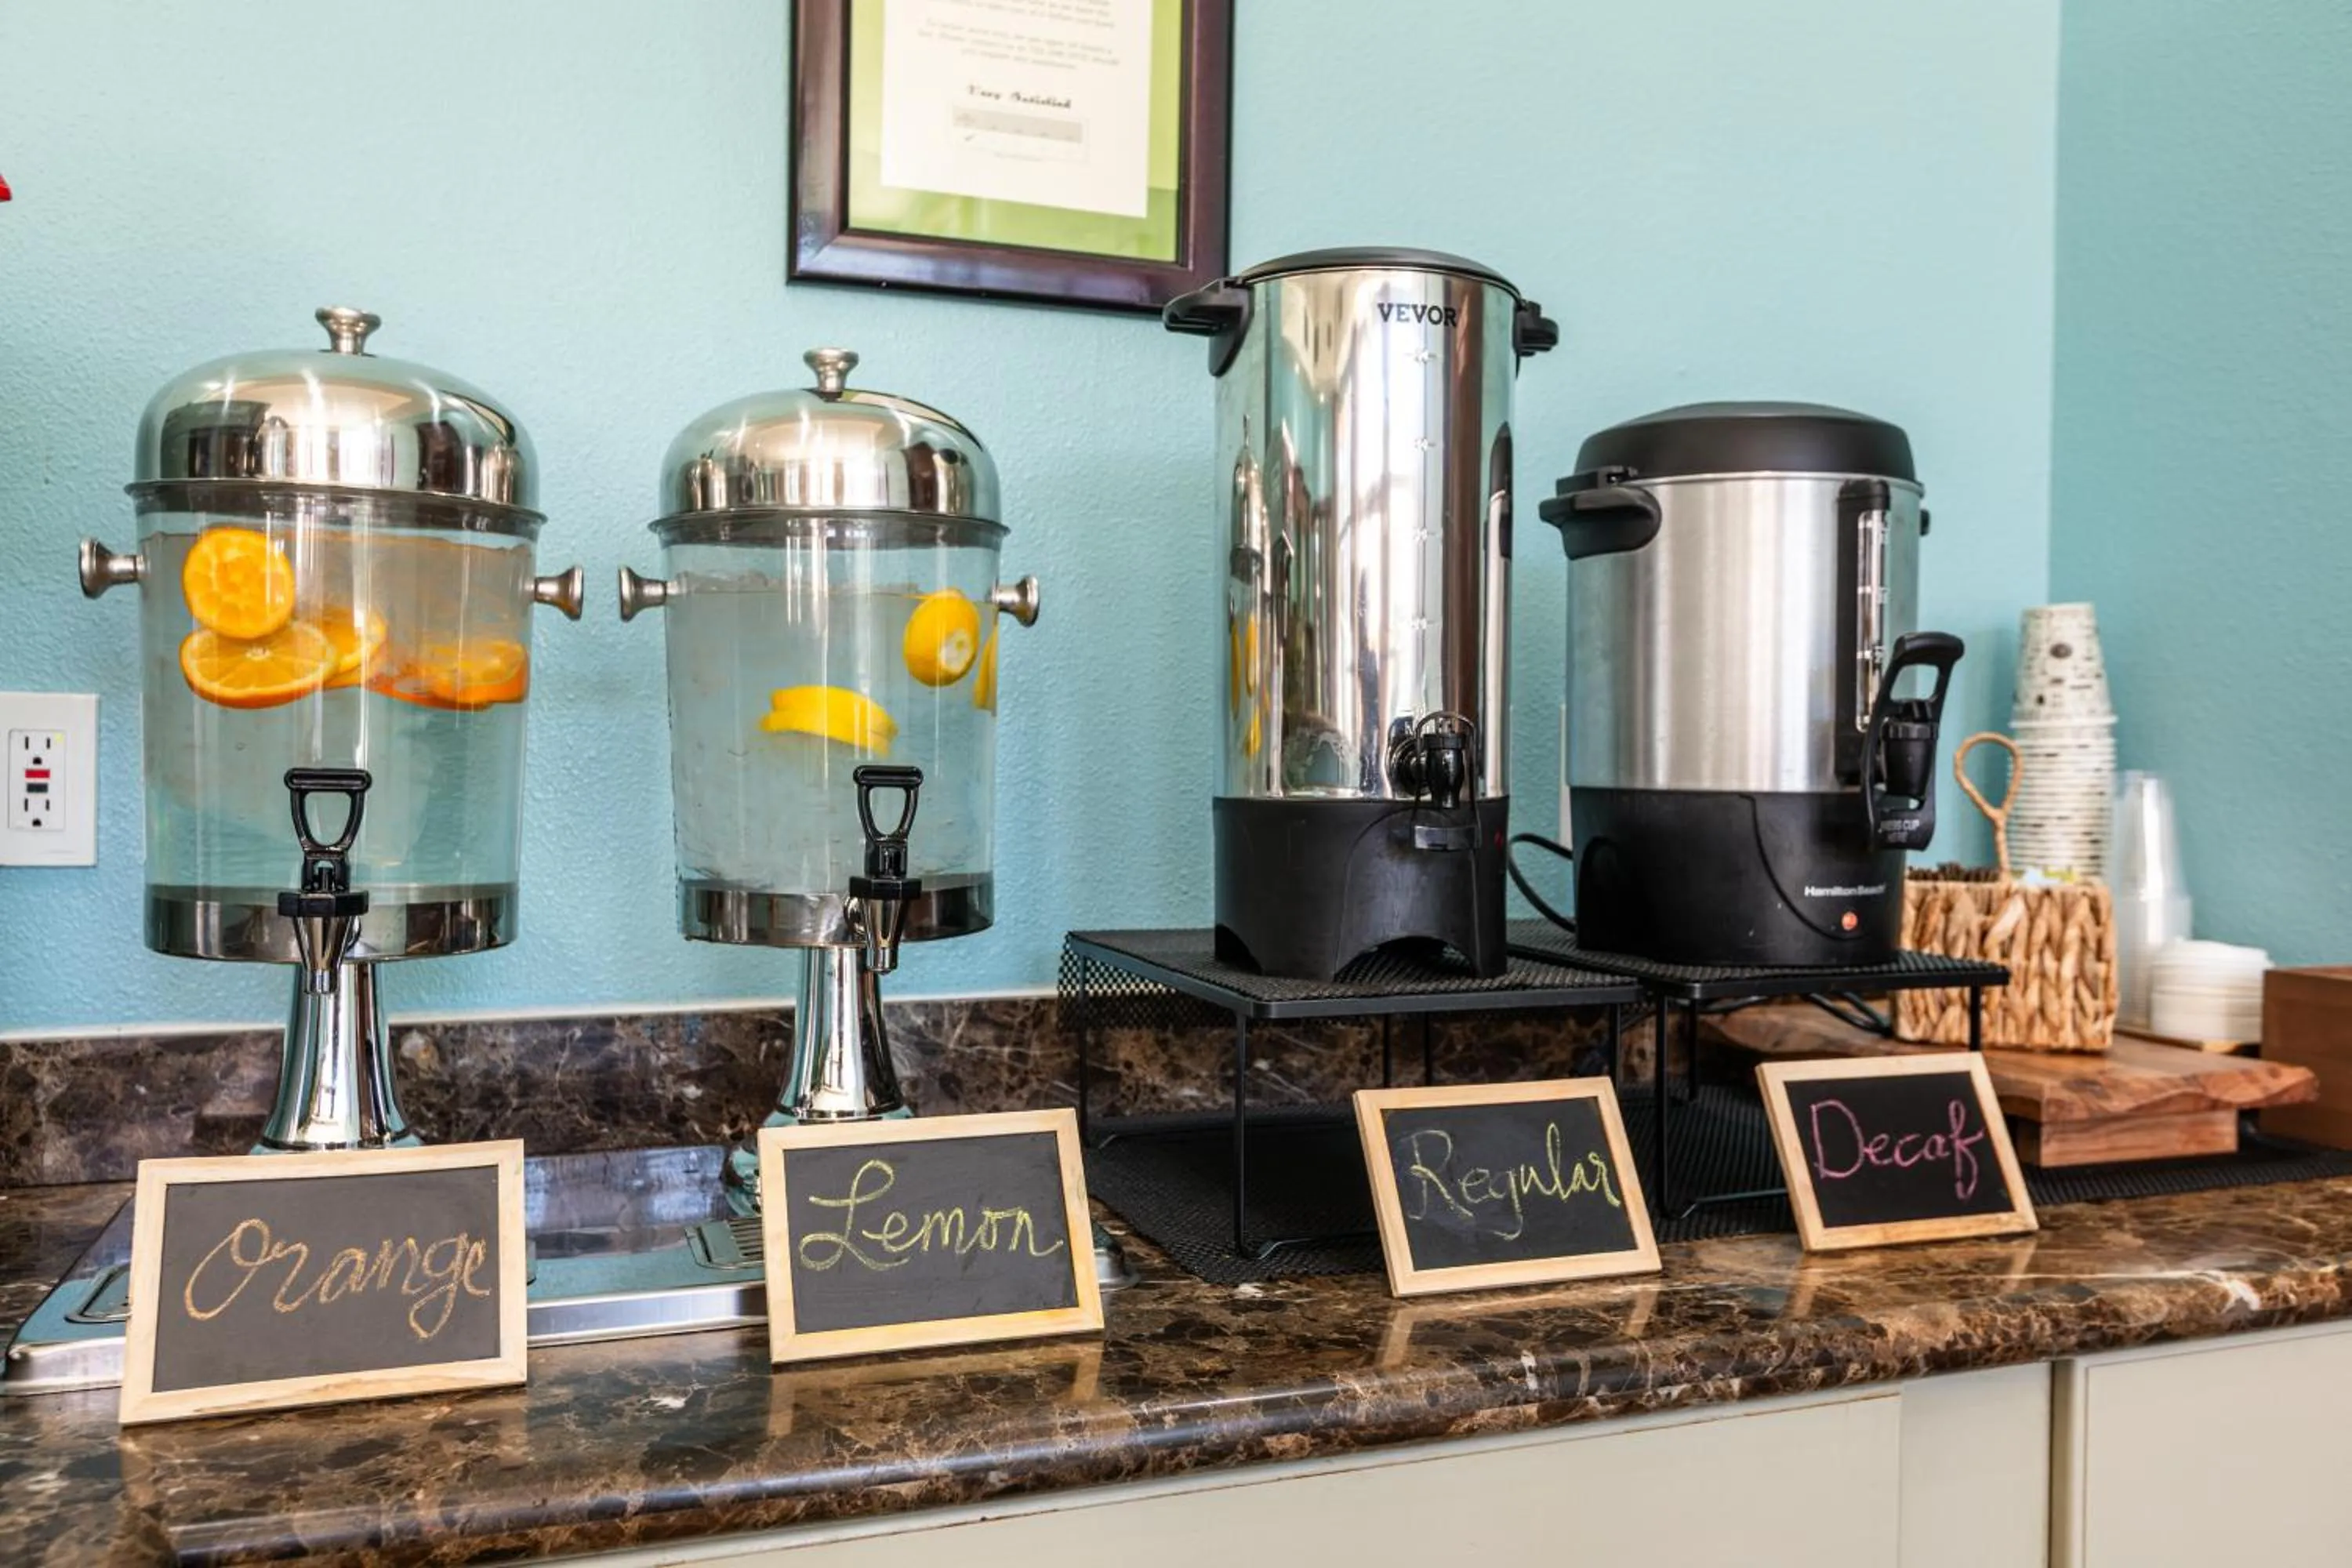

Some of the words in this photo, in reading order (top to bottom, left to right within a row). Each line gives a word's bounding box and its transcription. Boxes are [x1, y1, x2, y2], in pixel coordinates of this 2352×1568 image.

[1377, 303, 1457, 328] VEVOR
[1804, 885, 1857, 897] Hamilton
[1399, 1121, 1621, 1241] Regular
[1809, 1098, 1985, 1200] Decaf
[798, 1159, 1065, 1272] Lemon
[184, 1217, 492, 1341] Orange
